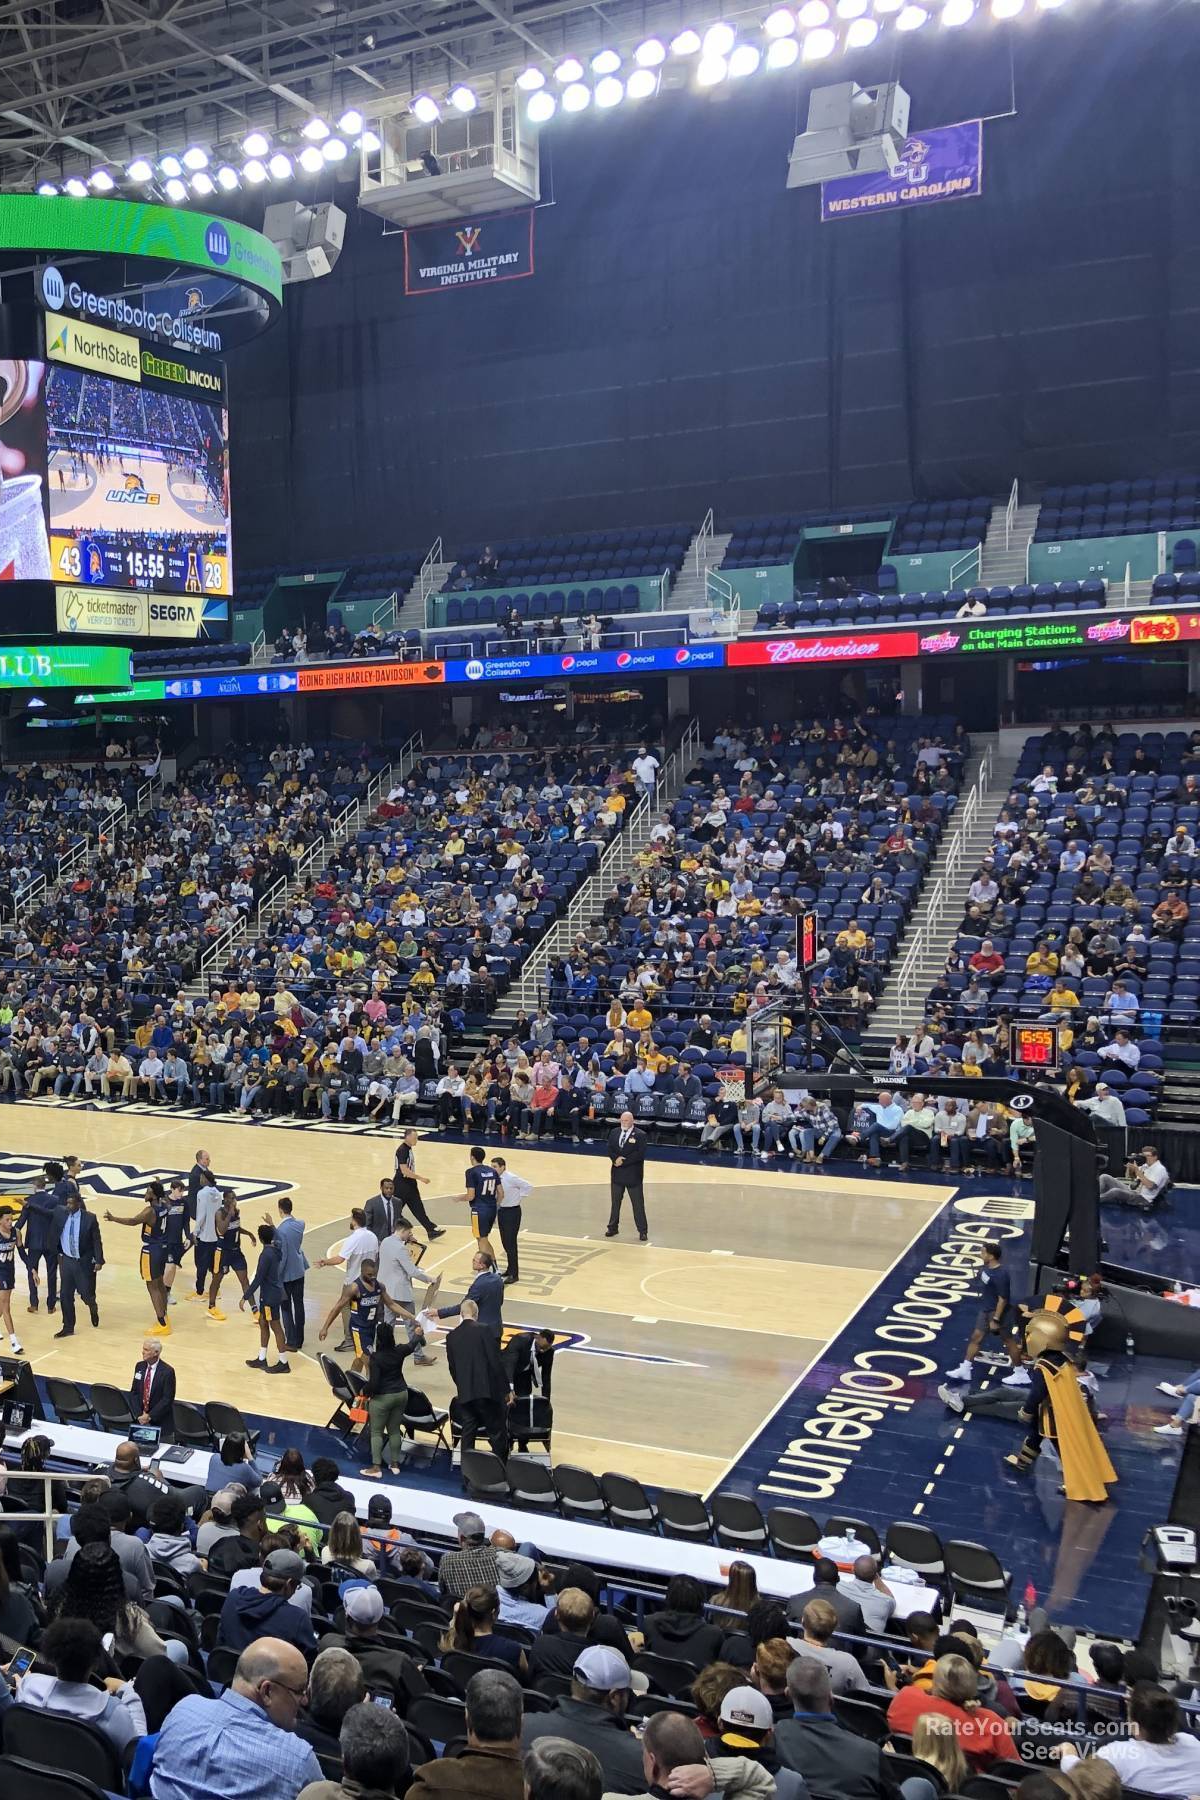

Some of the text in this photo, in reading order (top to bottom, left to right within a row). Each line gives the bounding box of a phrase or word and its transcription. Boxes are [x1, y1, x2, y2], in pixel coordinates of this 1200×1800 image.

[829, 177, 972, 212] WESTERN CAROLINA
[419, 252, 519, 278] VIRGINIA MILITARY
[440, 268, 497, 285] INSTITUTE
[68, 282, 221, 351] Greensboro Coliseum
[74, 334, 221, 392] NorthState GREEN LINCOLN
[106, 490, 160, 506] UNCG
[59, 546, 82, 577] 43
[126, 551, 165, 578] 15:55
[205, 562, 222, 589] 28
[87, 600, 137, 616] ticketmaster
[150, 603, 195, 621] SEGRA
[87, 615, 136, 627] VERIFIED TICKETS
[969, 626, 1023, 640] Charging
[1025, 624, 1077, 636] Stations
[977, 641, 994, 649] the
[997, 638, 1023, 648] Main
[1026, 635, 1083, 647] Concourse
[691, 652, 714, 662] pepsi
[766, 640, 881, 663] Budweiser
[485, 659, 530, 669] Greensboro
[576, 659, 597, 669] pepsi
[633, 655, 655, 665] pepsi
[299, 669, 414, 687] RIDING HIGH HARLEY-DAVIDSON
[485, 668, 521, 676] Coliseum
[1021, 1031, 1052, 1044] 15:55
[1022, 1045, 1047, 1062] 30
[873, 1076, 908, 1085] SPALDING
[481, 1179, 495, 1195] 14
[367, 1308, 376, 1320] 2
[757, 1222, 1024, 1499] Greensboro Coliseum
